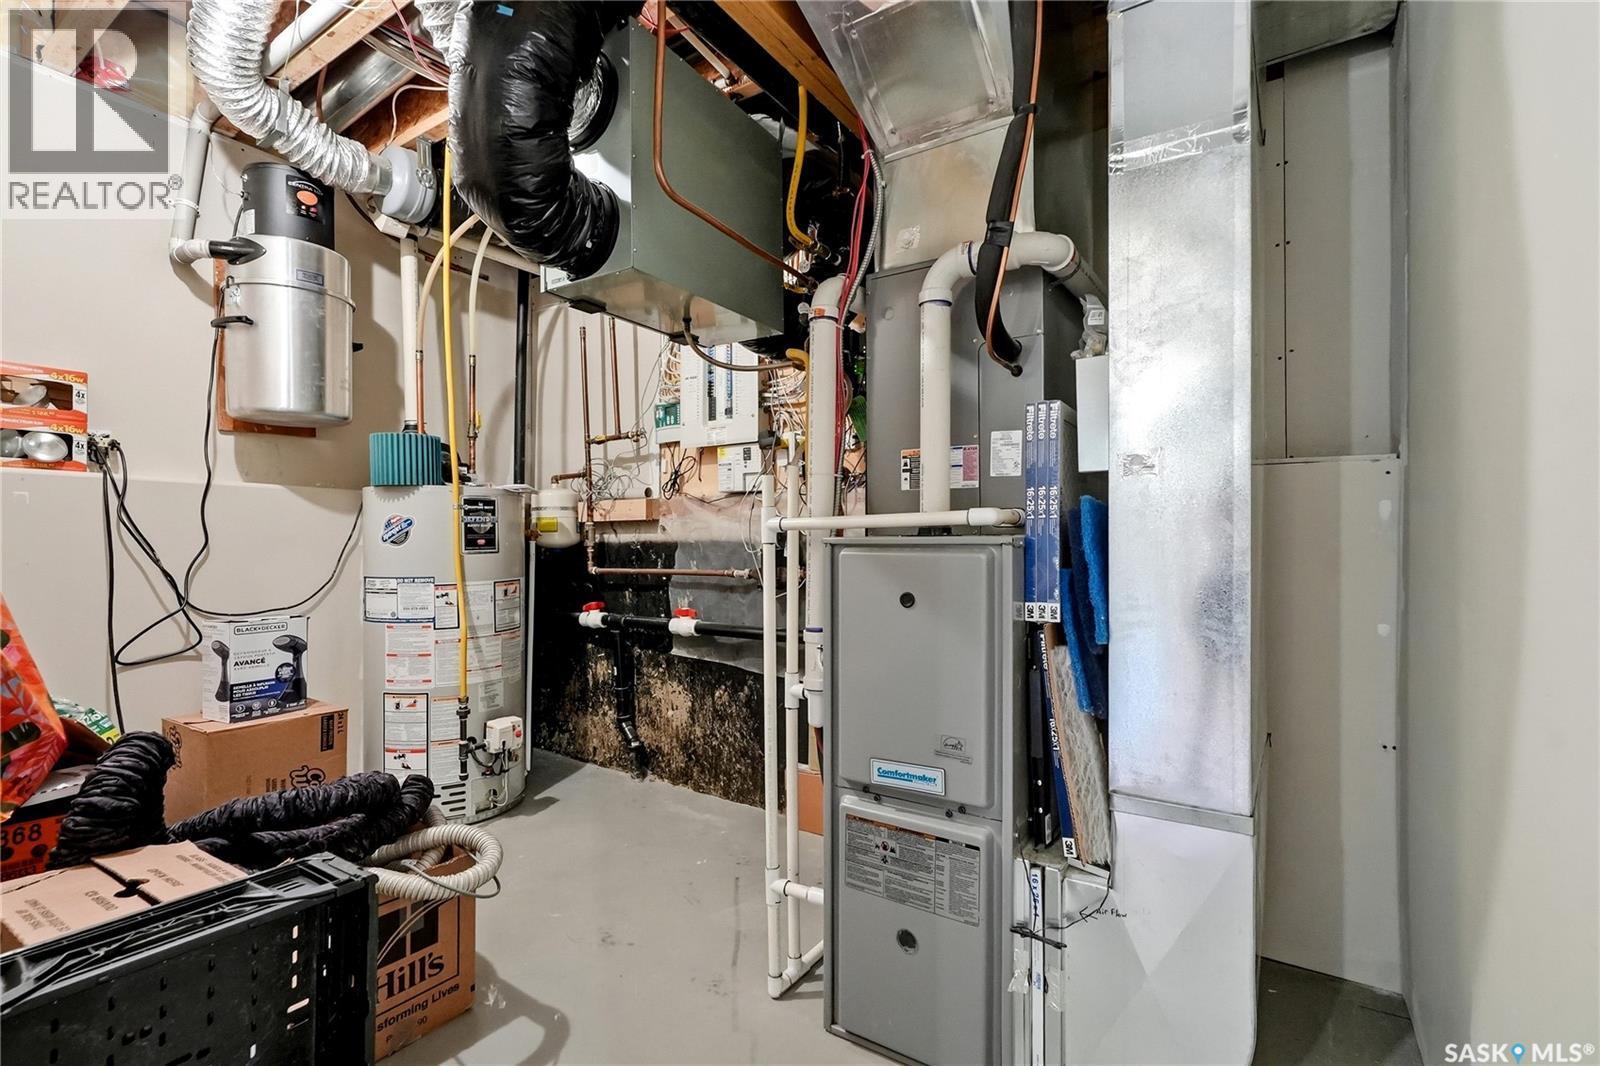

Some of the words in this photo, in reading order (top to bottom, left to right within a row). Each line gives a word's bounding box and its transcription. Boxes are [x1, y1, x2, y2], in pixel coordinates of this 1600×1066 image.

[1026, 405, 1035, 441] Filtrete
[1038, 403, 1047, 440] Filtrete
[1049, 402, 1059, 439] Filtrete
[1026, 487, 1035, 519] 16x25x1
[1038, 485, 1047, 519] 16x25x1
[1049, 485, 1058, 519] 16x25x1
[1026, 604, 1035, 619] 3M
[233, 656, 266, 667] AVANCÉ
[877, 767, 937, 784] Comfortmaker
[1064, 839, 1076, 856] 3M
[377, 951, 445, 1004] Hill's
[431, 983, 460, 1002] Lives
